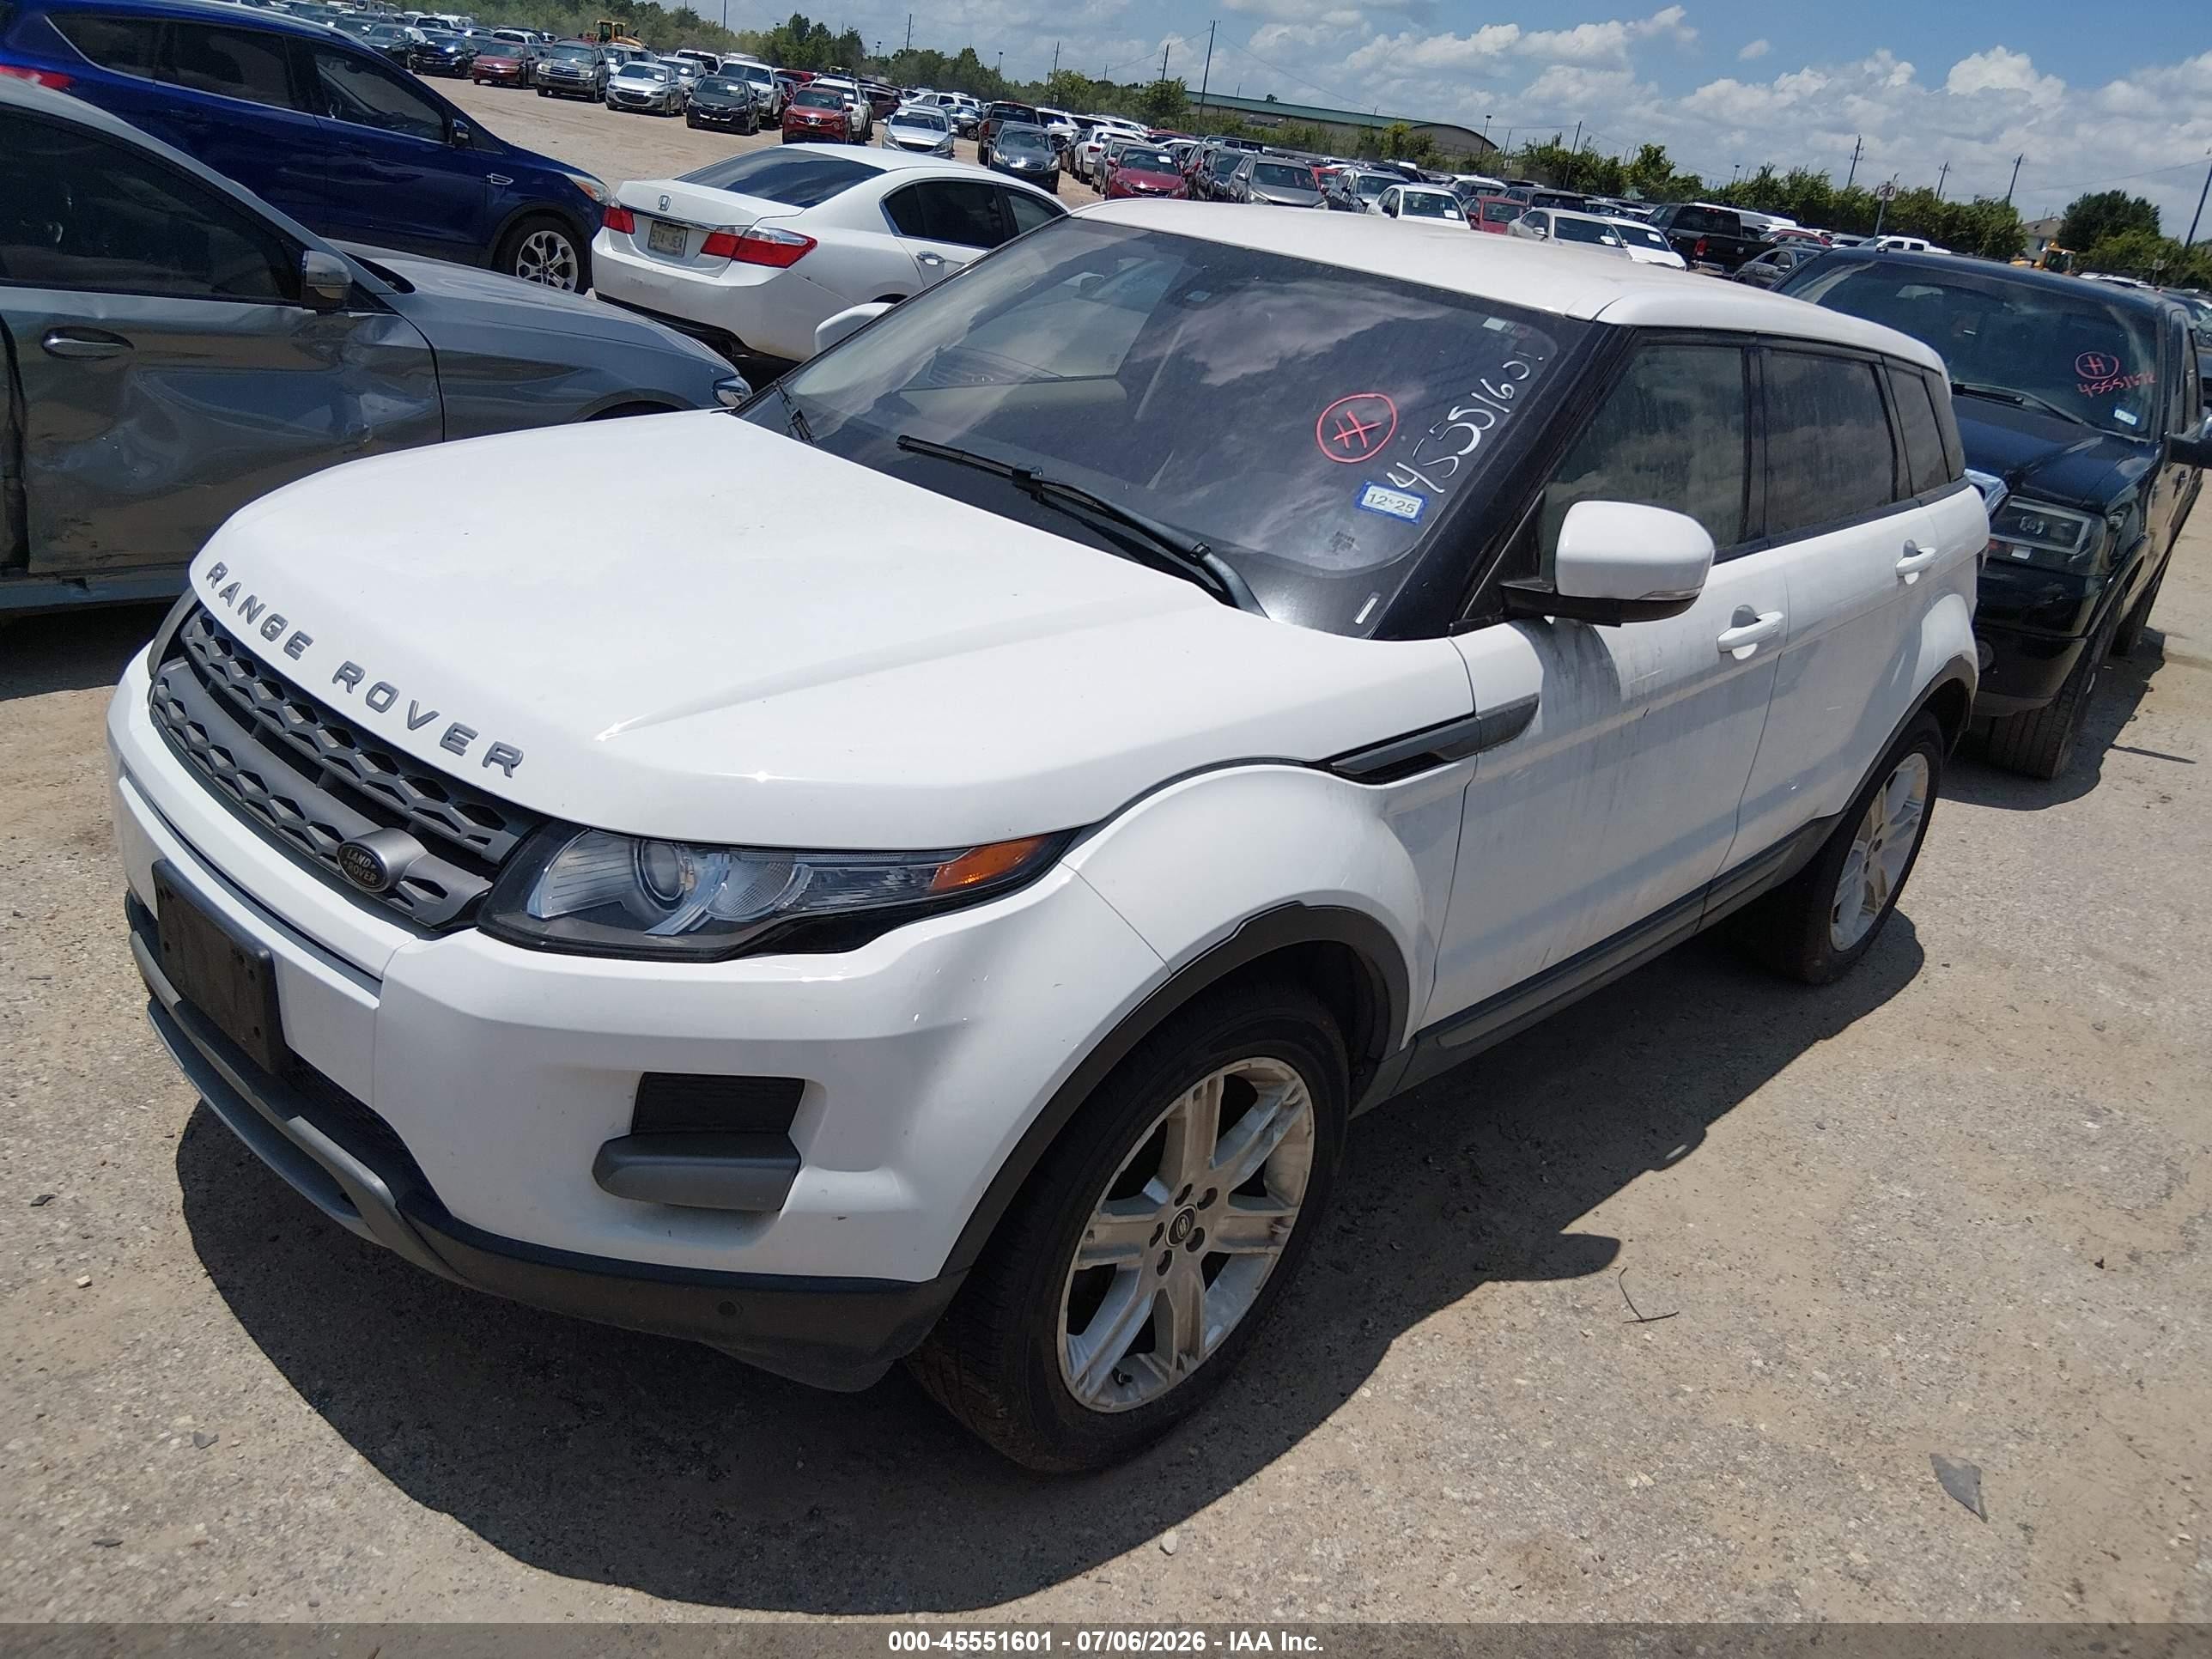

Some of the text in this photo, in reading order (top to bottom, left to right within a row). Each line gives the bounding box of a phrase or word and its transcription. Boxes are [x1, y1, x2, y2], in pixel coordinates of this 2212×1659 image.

[206, 561, 525, 779] RANGE ROVER
[346, 848, 372, 868] LAND
[346, 861, 378, 884] ROVER
